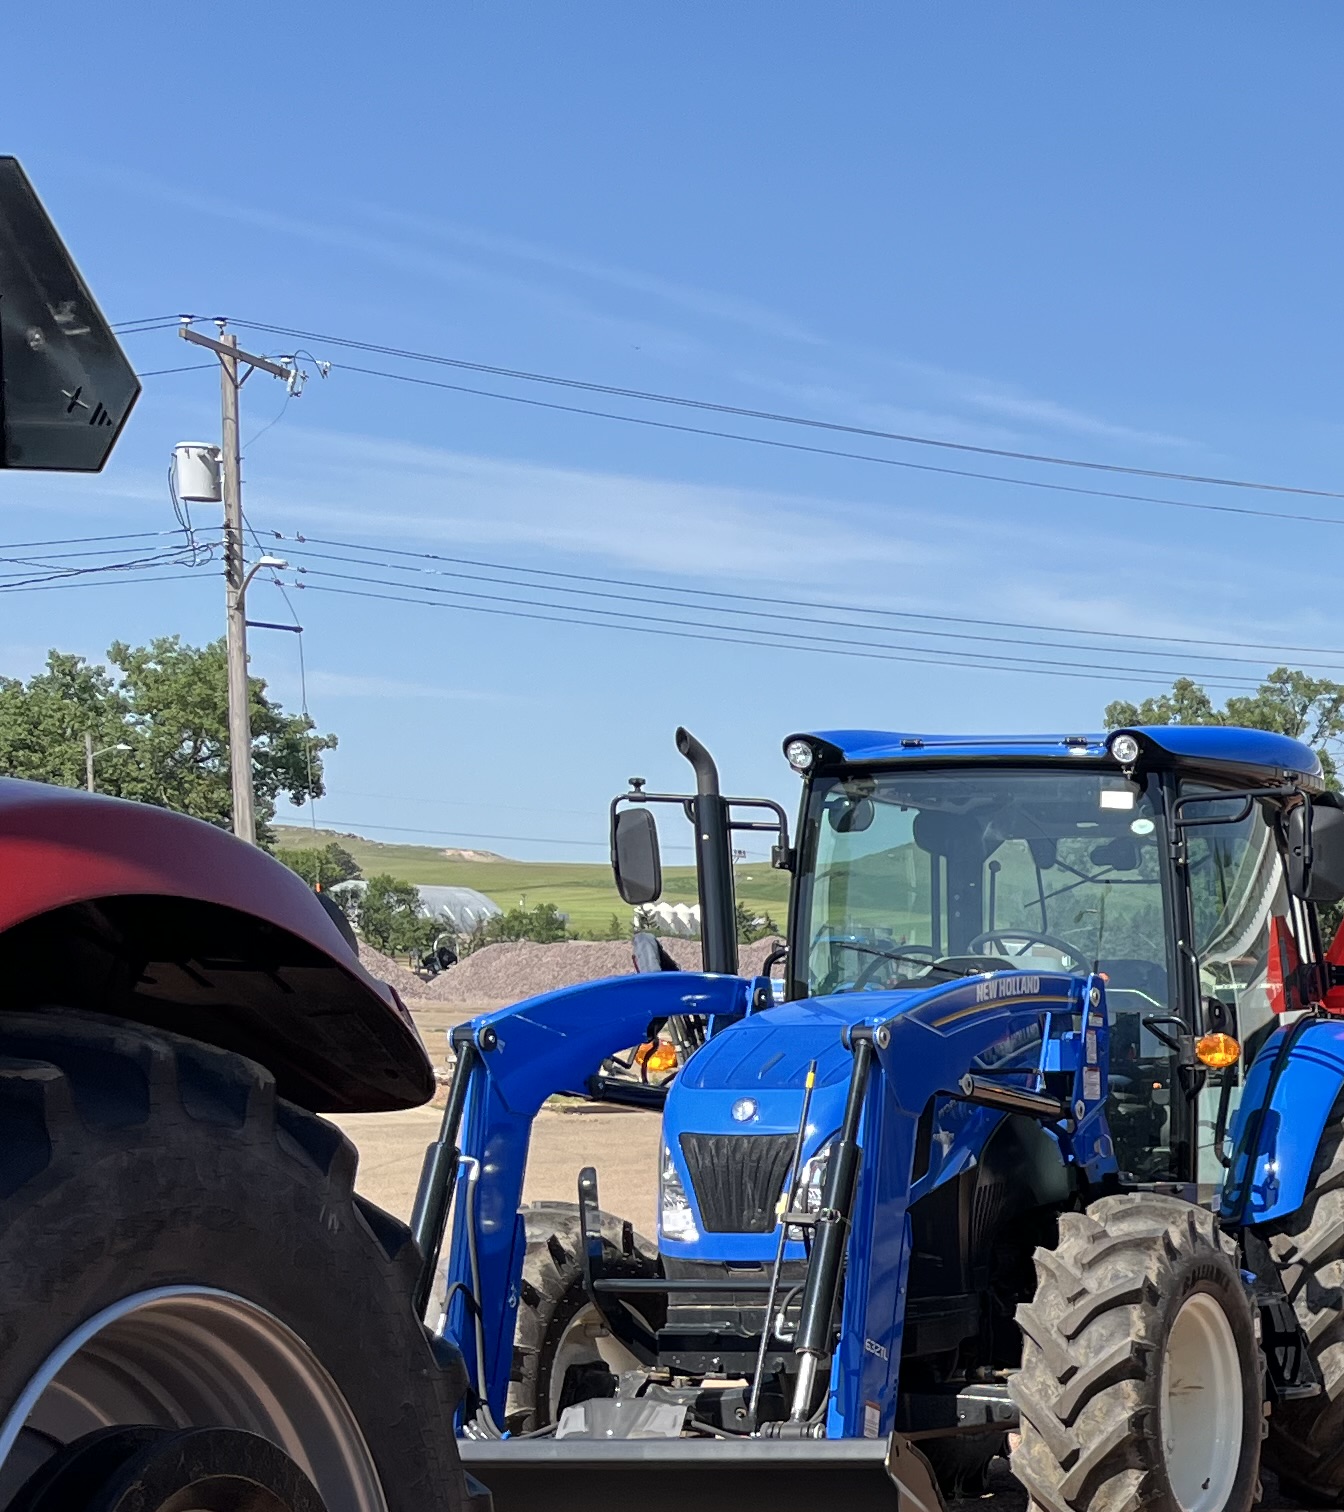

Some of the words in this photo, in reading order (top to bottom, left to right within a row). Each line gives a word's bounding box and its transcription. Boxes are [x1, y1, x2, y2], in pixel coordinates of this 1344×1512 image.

[976, 980, 998, 1003] NEW
[998, 975, 1040, 998] HOLLAND
[865, 1338, 888, 1361] 632TL
